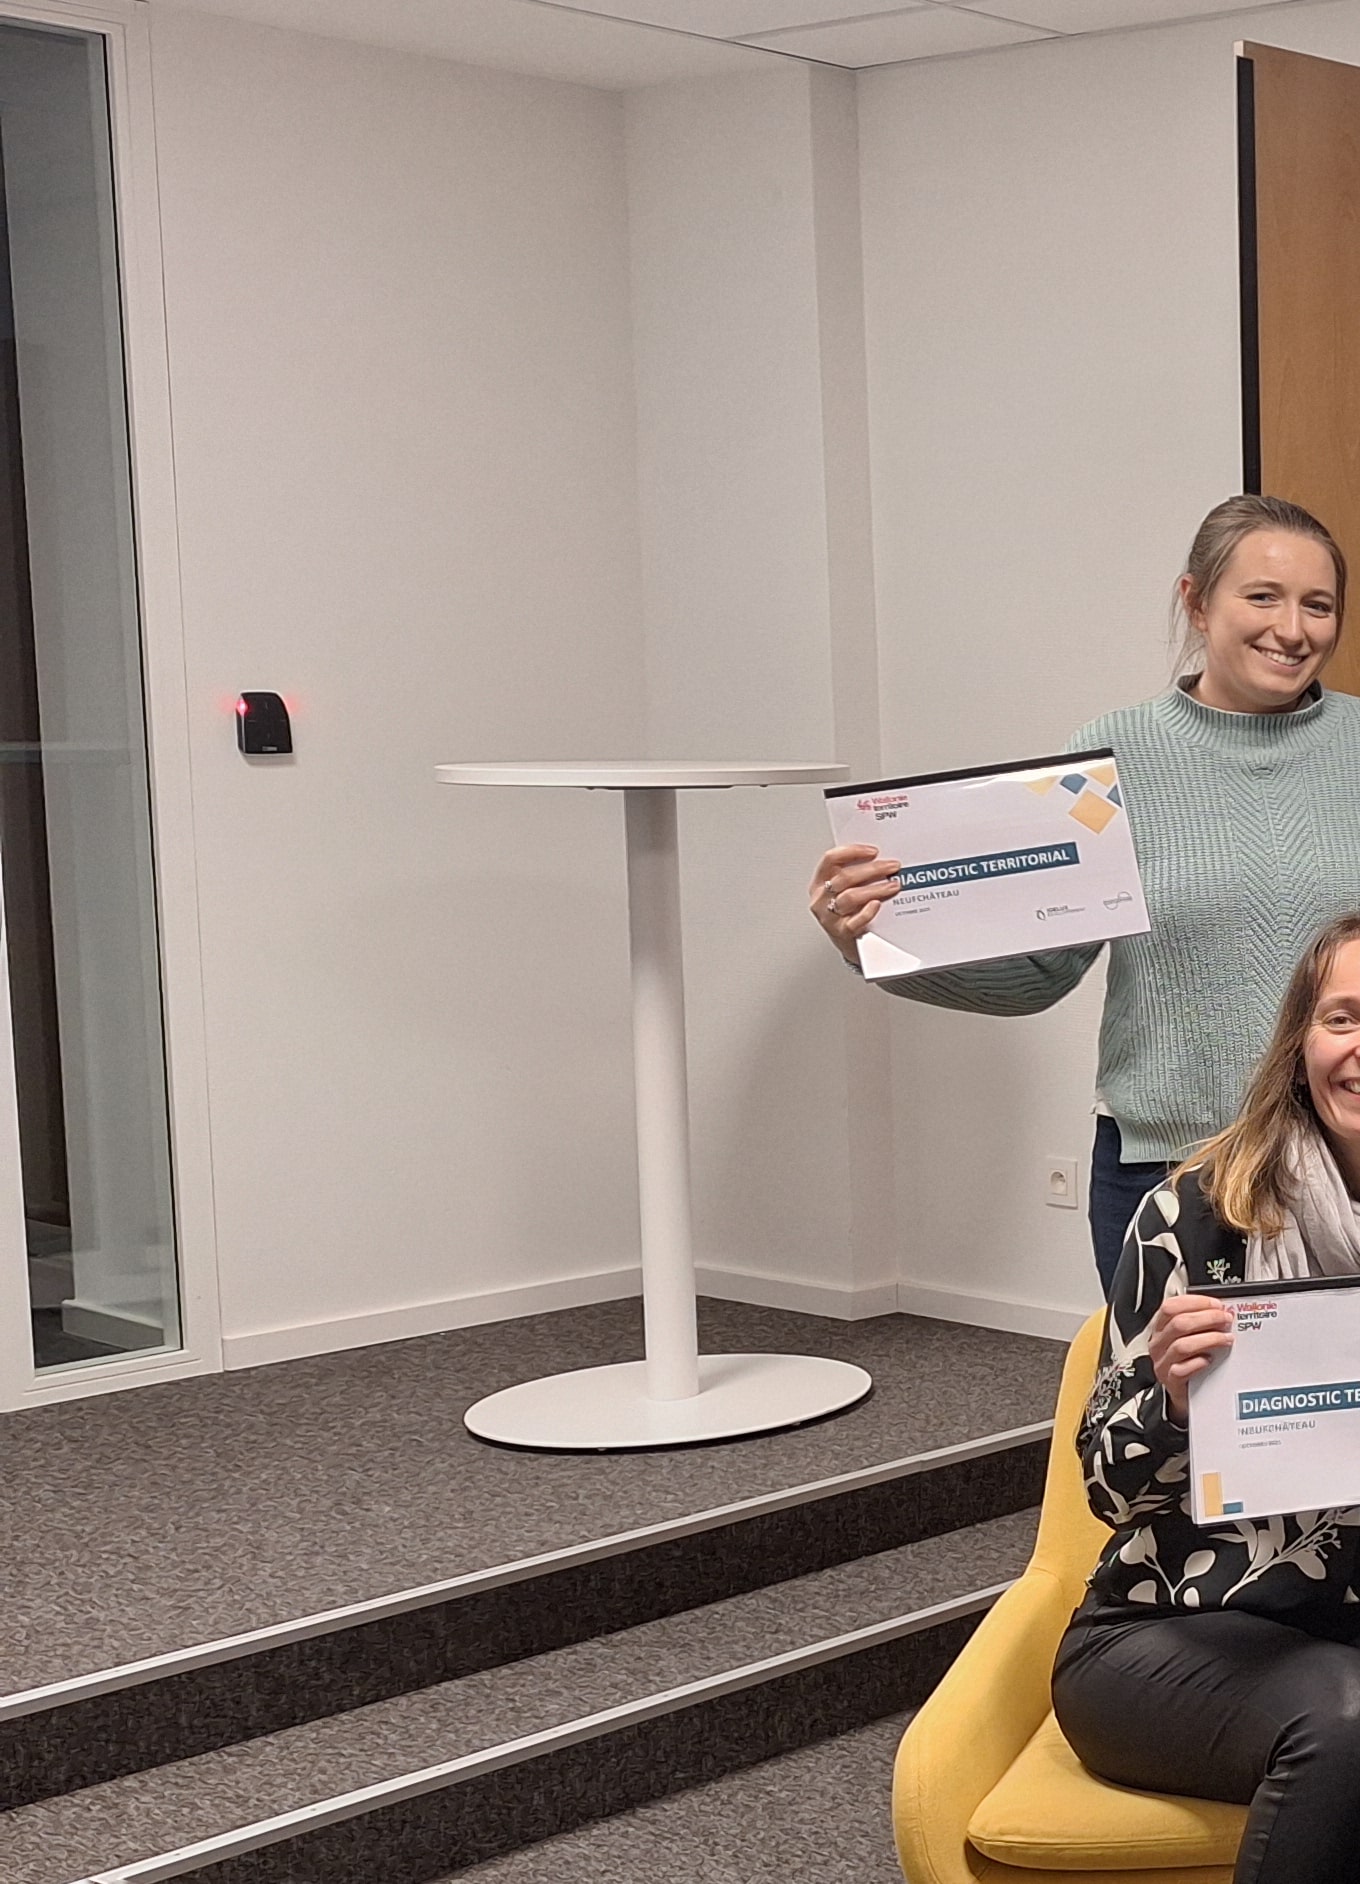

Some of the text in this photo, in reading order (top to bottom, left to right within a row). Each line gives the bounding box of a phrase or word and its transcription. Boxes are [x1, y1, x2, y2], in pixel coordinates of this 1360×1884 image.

[875, 811, 897, 820] SPW
[979, 849, 1071, 873] TERRITORIAL
[893, 889, 960, 906] NEUFCHÂTEAU
[1237, 1301, 1277, 1312] Wallonie
[1237, 1321, 1262, 1332] SPW
[1242, 1390, 1341, 1414] DIAGNOSTIC
